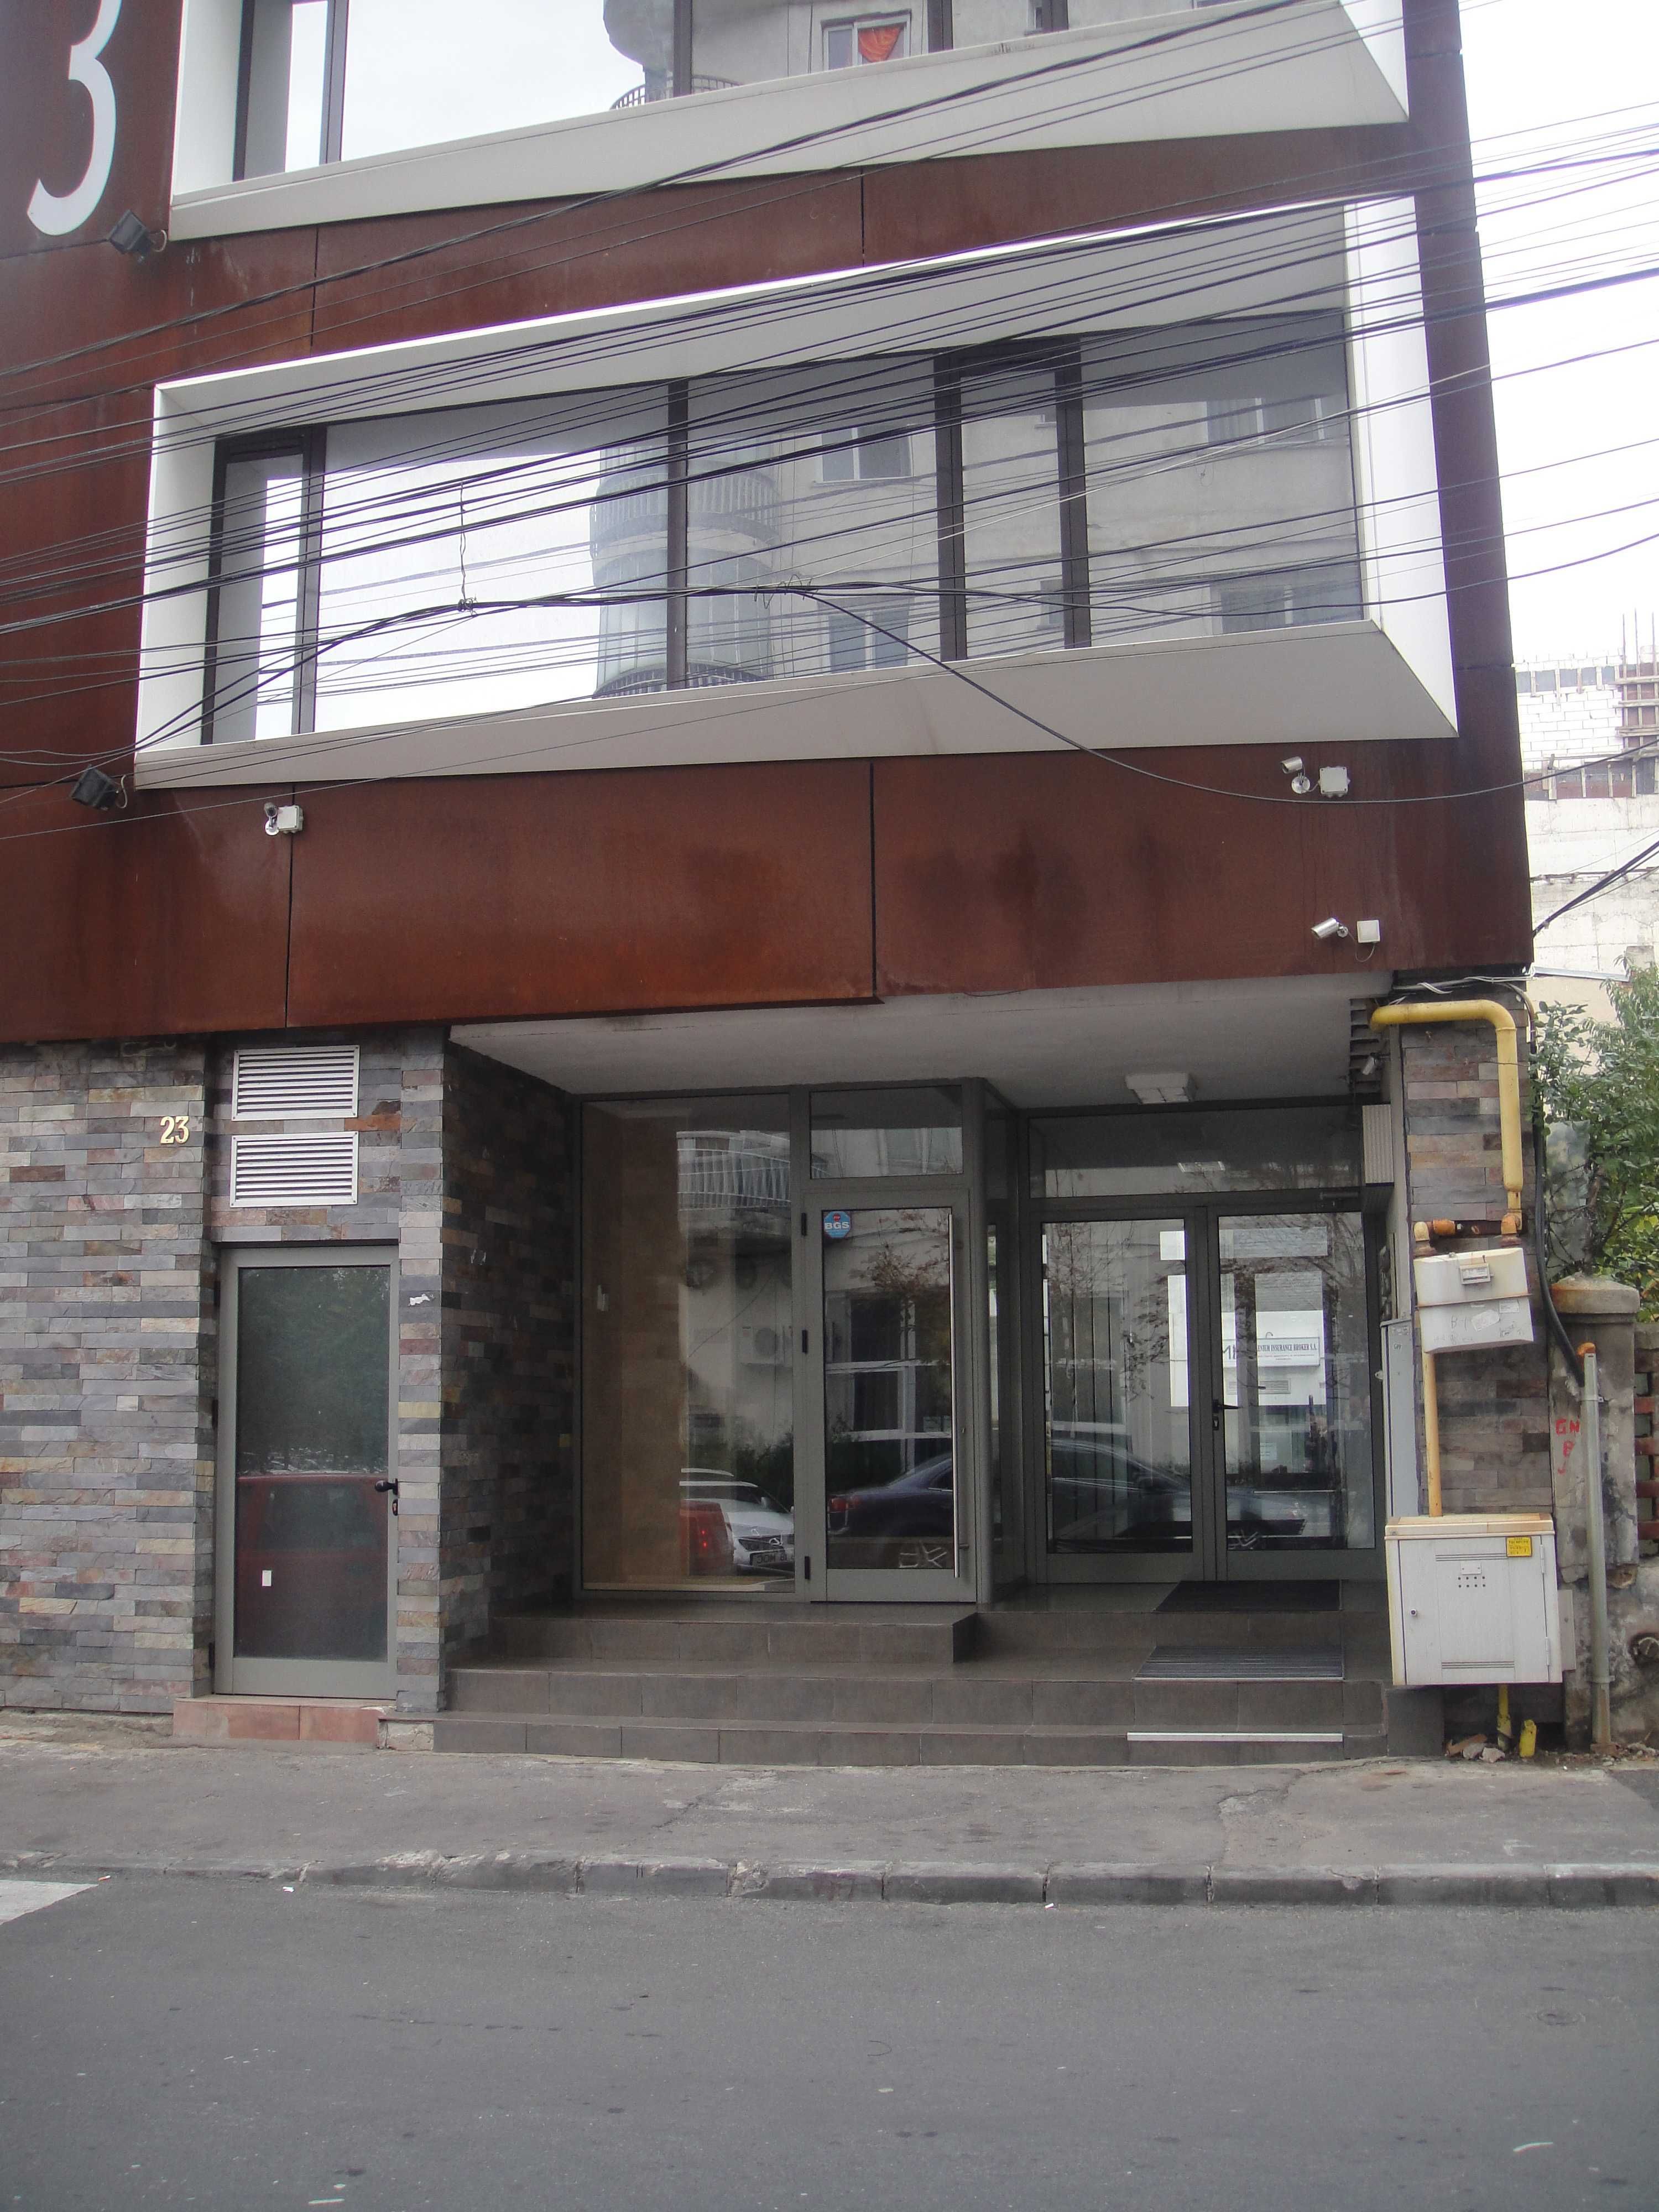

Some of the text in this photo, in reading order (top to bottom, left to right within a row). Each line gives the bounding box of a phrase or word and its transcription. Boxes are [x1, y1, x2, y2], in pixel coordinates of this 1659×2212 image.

[27, 0, 122, 236] 3
[160, 1115, 189, 1144] 23
[824, 1222, 850, 1230] BGS
